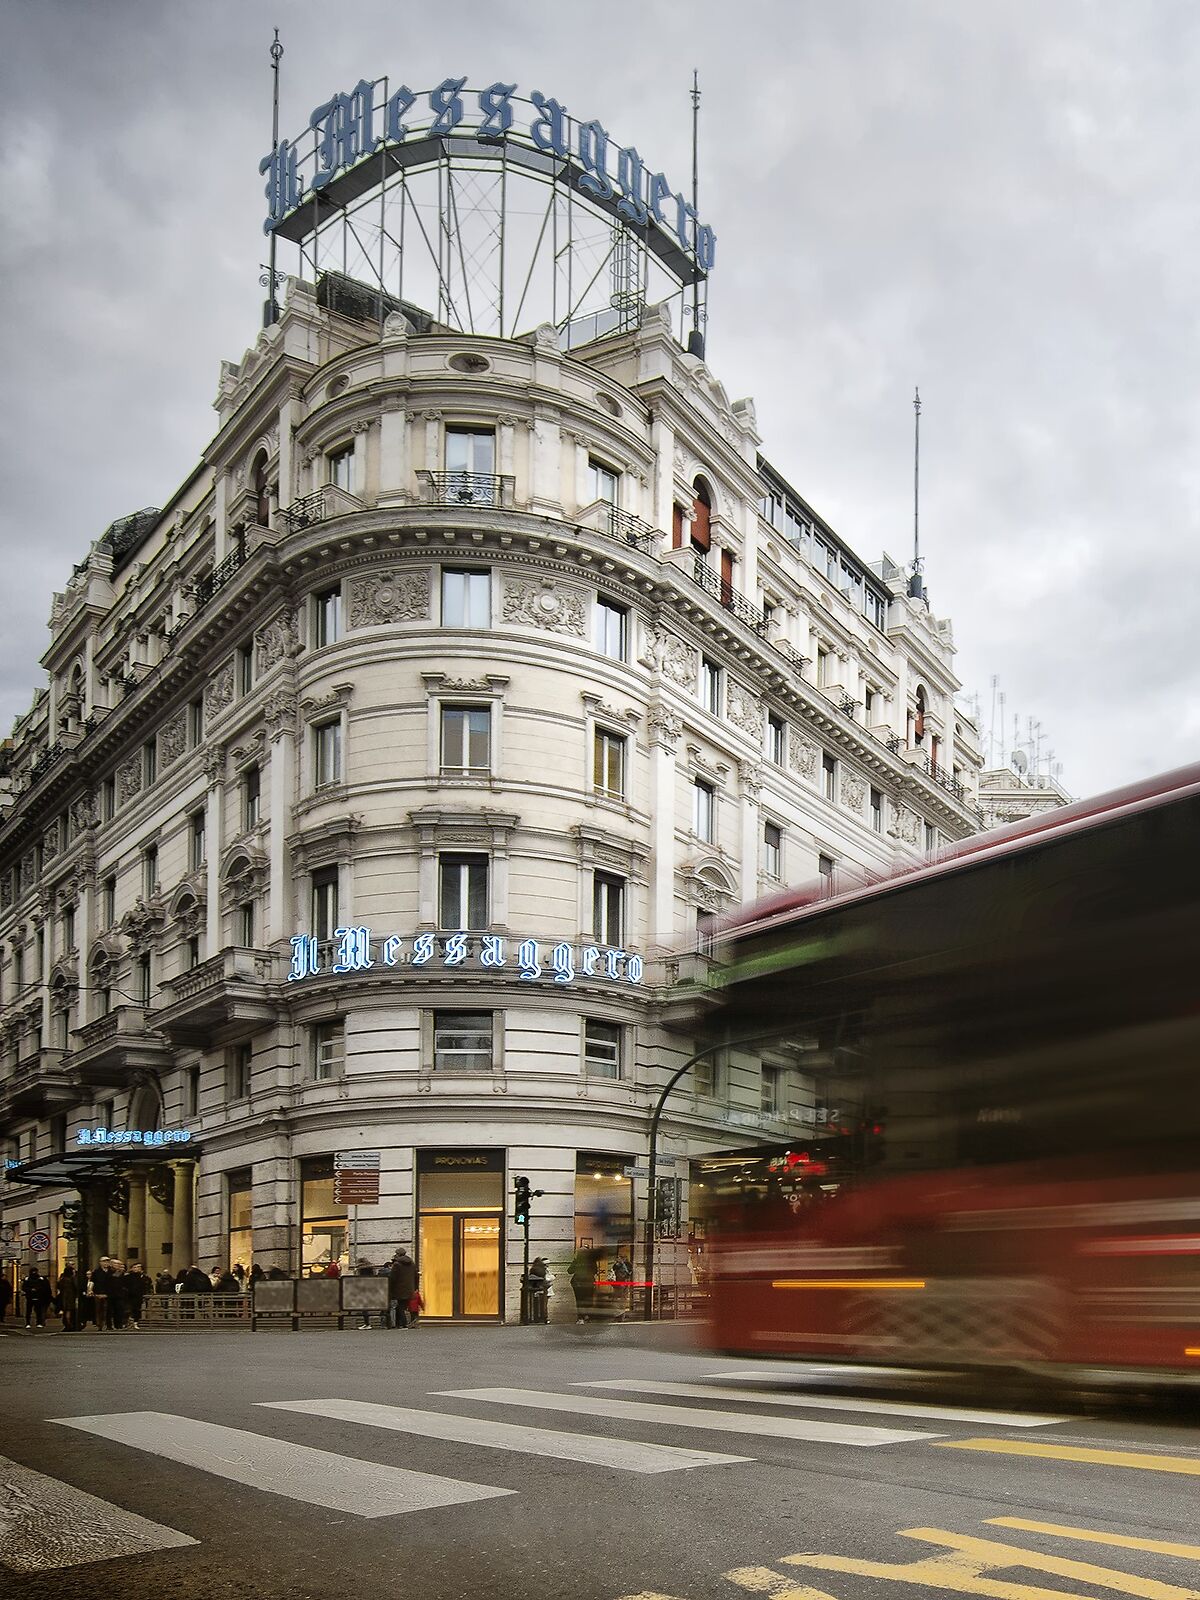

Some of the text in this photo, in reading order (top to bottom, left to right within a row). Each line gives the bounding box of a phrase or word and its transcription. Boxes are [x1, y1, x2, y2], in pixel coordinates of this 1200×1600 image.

[309, 76, 718, 271] Messaggero
[287, 925, 645, 983] Il Messaggero
